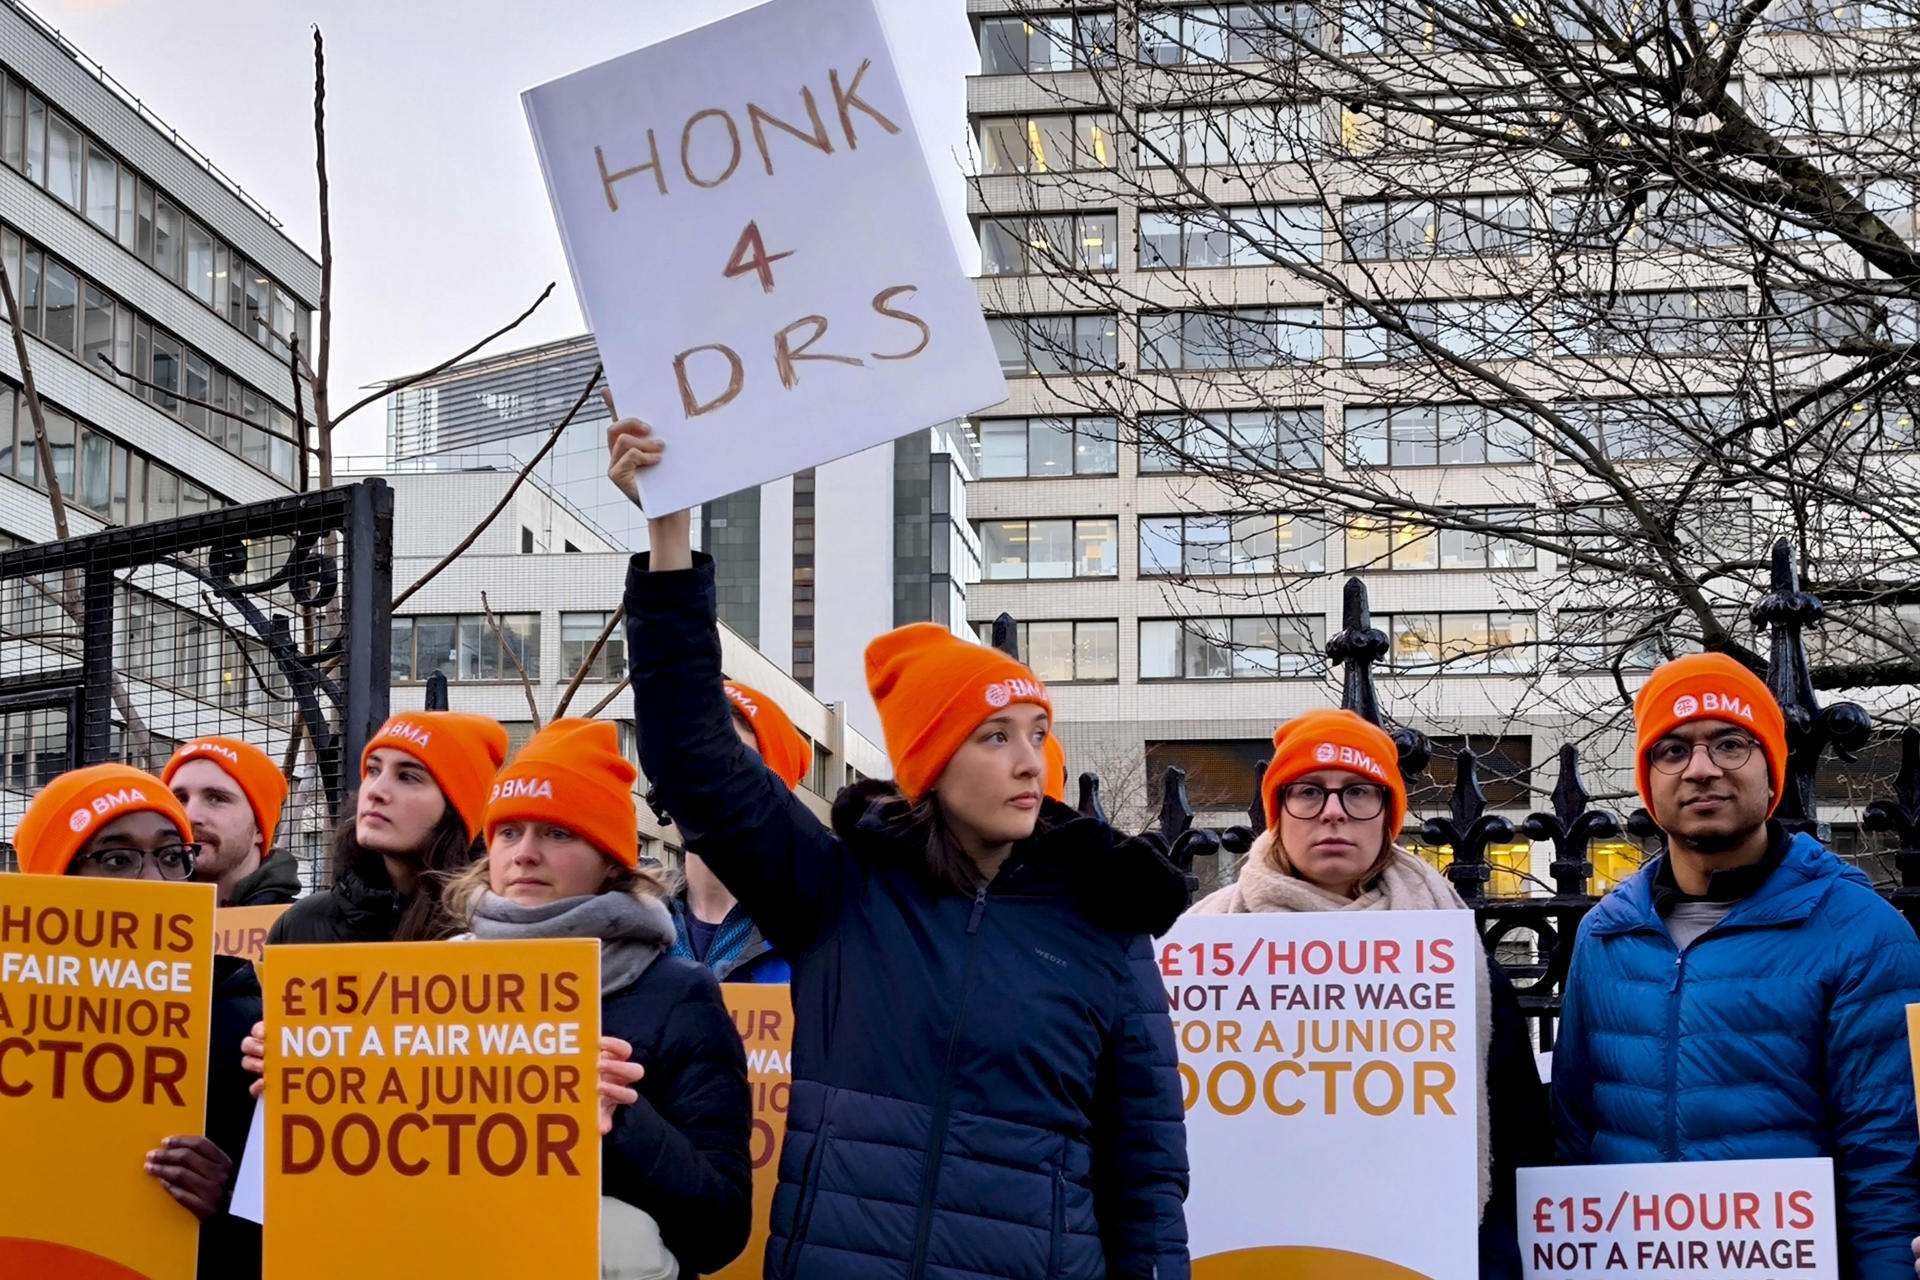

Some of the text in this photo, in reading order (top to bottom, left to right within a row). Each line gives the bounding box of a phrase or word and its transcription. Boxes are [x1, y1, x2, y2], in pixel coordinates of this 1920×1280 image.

[594, 58, 901, 212] HONK
[722, 219, 795, 293] 4
[672, 285, 931, 420] DRS
[1702, 692, 1754, 722] BMA
[200, 743, 239, 763] BMA
[389, 720, 432, 748] BMA
[1340, 746, 1388, 780] BMA
[91, 788, 147, 816] BMA
[501, 777, 553, 799] BMA
[153, 913, 195, 953] IS
[2, 952, 192, 993] FAIR WAGE
[1159, 937, 1455, 977] £15/HOUR IS
[281, 971, 581, 1016] £15/HOUR IS
[1236, 985, 1261, 1010] A
[1270, 984, 1346, 1010] FAIR
[1354, 983, 1456, 1010] WAGE
[22, 993, 191, 1039] JUNIOR
[280, 1022, 580, 1057] NOT A FAIR WAGE
[1172, 1018, 1457, 1059] OR A JUNIOR
[281, 1065, 581, 1112] FOR A JUNIOR
[281, 1112, 581, 1177] DOCTOR
[1533, 1190, 1815, 1233] £15/HOUR IS
[1533, 1239, 1817, 1270] NOT A FAIR WAGE
